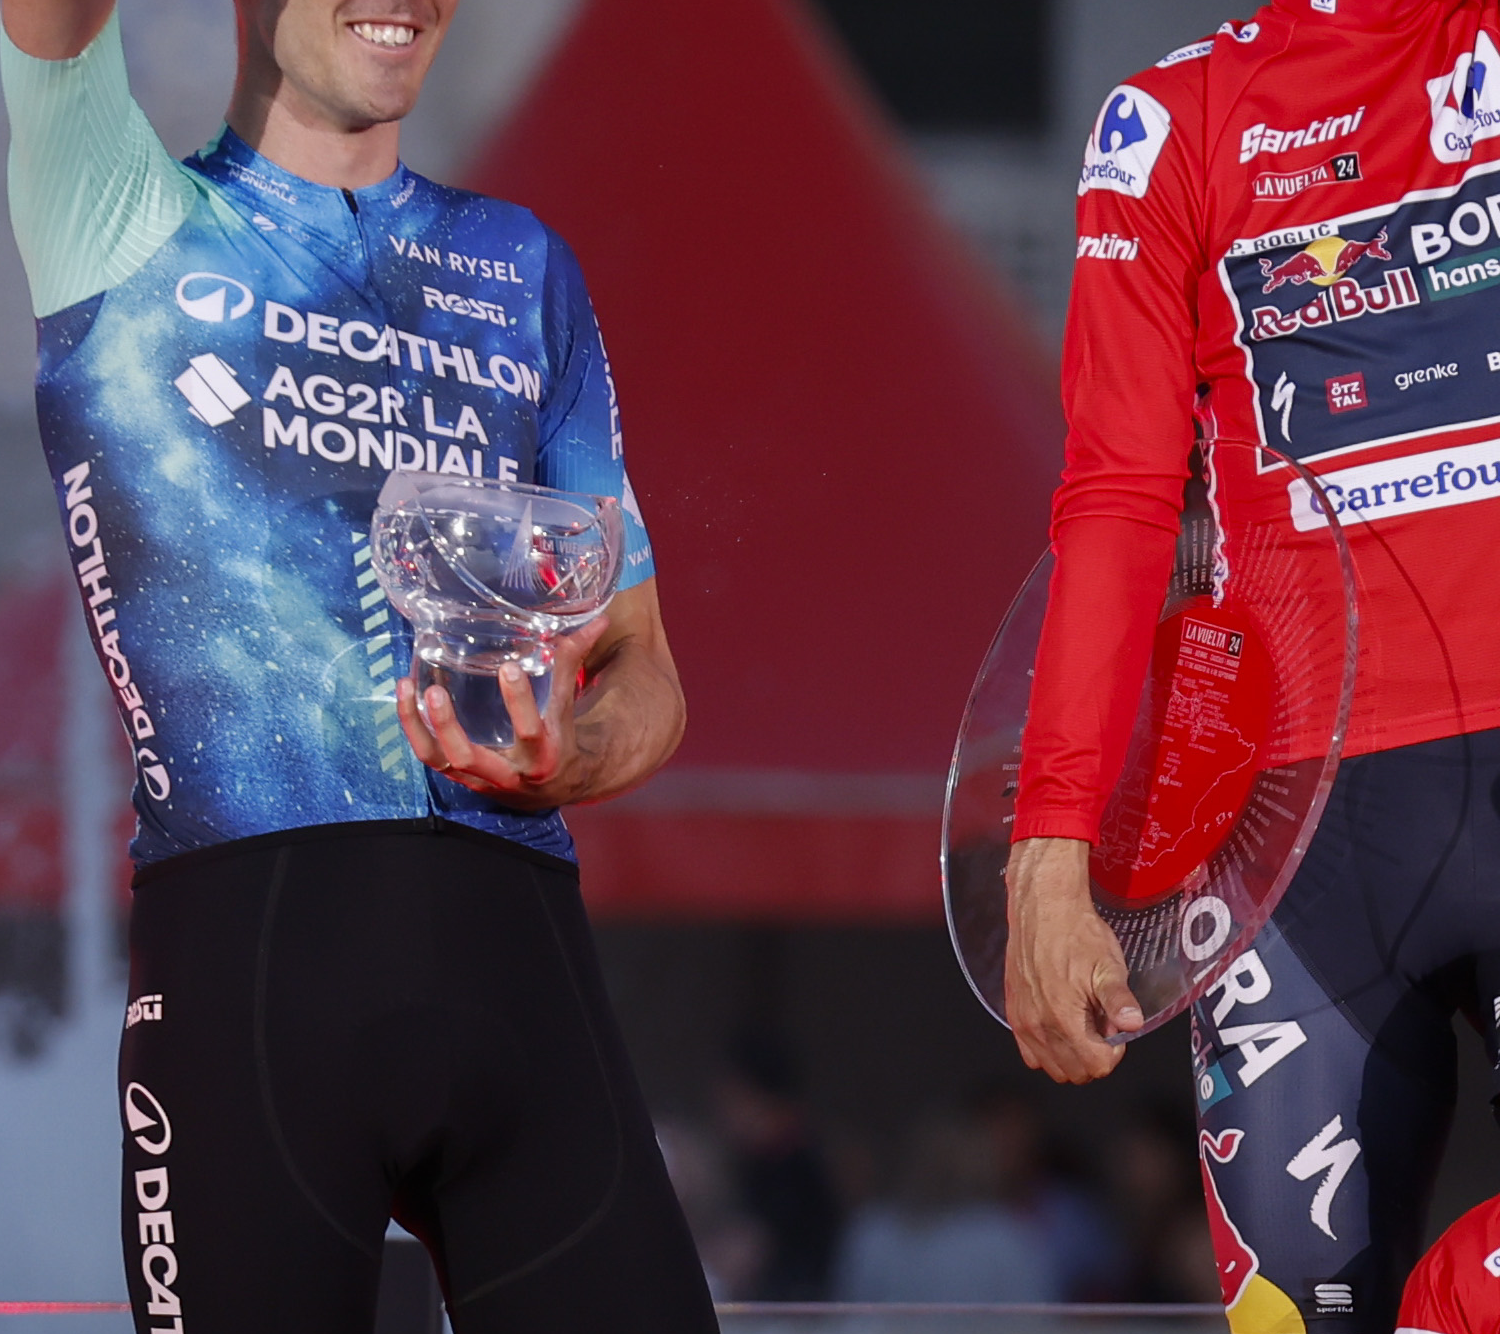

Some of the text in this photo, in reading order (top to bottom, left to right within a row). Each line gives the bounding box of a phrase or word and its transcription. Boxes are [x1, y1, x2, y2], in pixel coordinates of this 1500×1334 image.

[1239, 106, 1366, 164] Santini
[1255, 158, 1355, 196] LA VUELTA 24
[388, 234, 523, 283] VAN RYSEL
[1230, 224, 1331, 255] P. ROGLIČ
[1251, 268, 1419, 340] Red Bull
[264, 299, 542, 407] DECATHLON
[1394, 361, 1459, 391] grenke
[264, 365, 490, 446] AG2R LA
[1331, 381, 1361, 397] ÖTZ
[1332, 395, 1362, 409] TAL
[264, 413, 519, 491] MONDIALE
[63, 461, 155, 740] DECATHLON
[1197, 625, 1226, 649] VUELTA
[1228, 636, 1241, 653] 24
